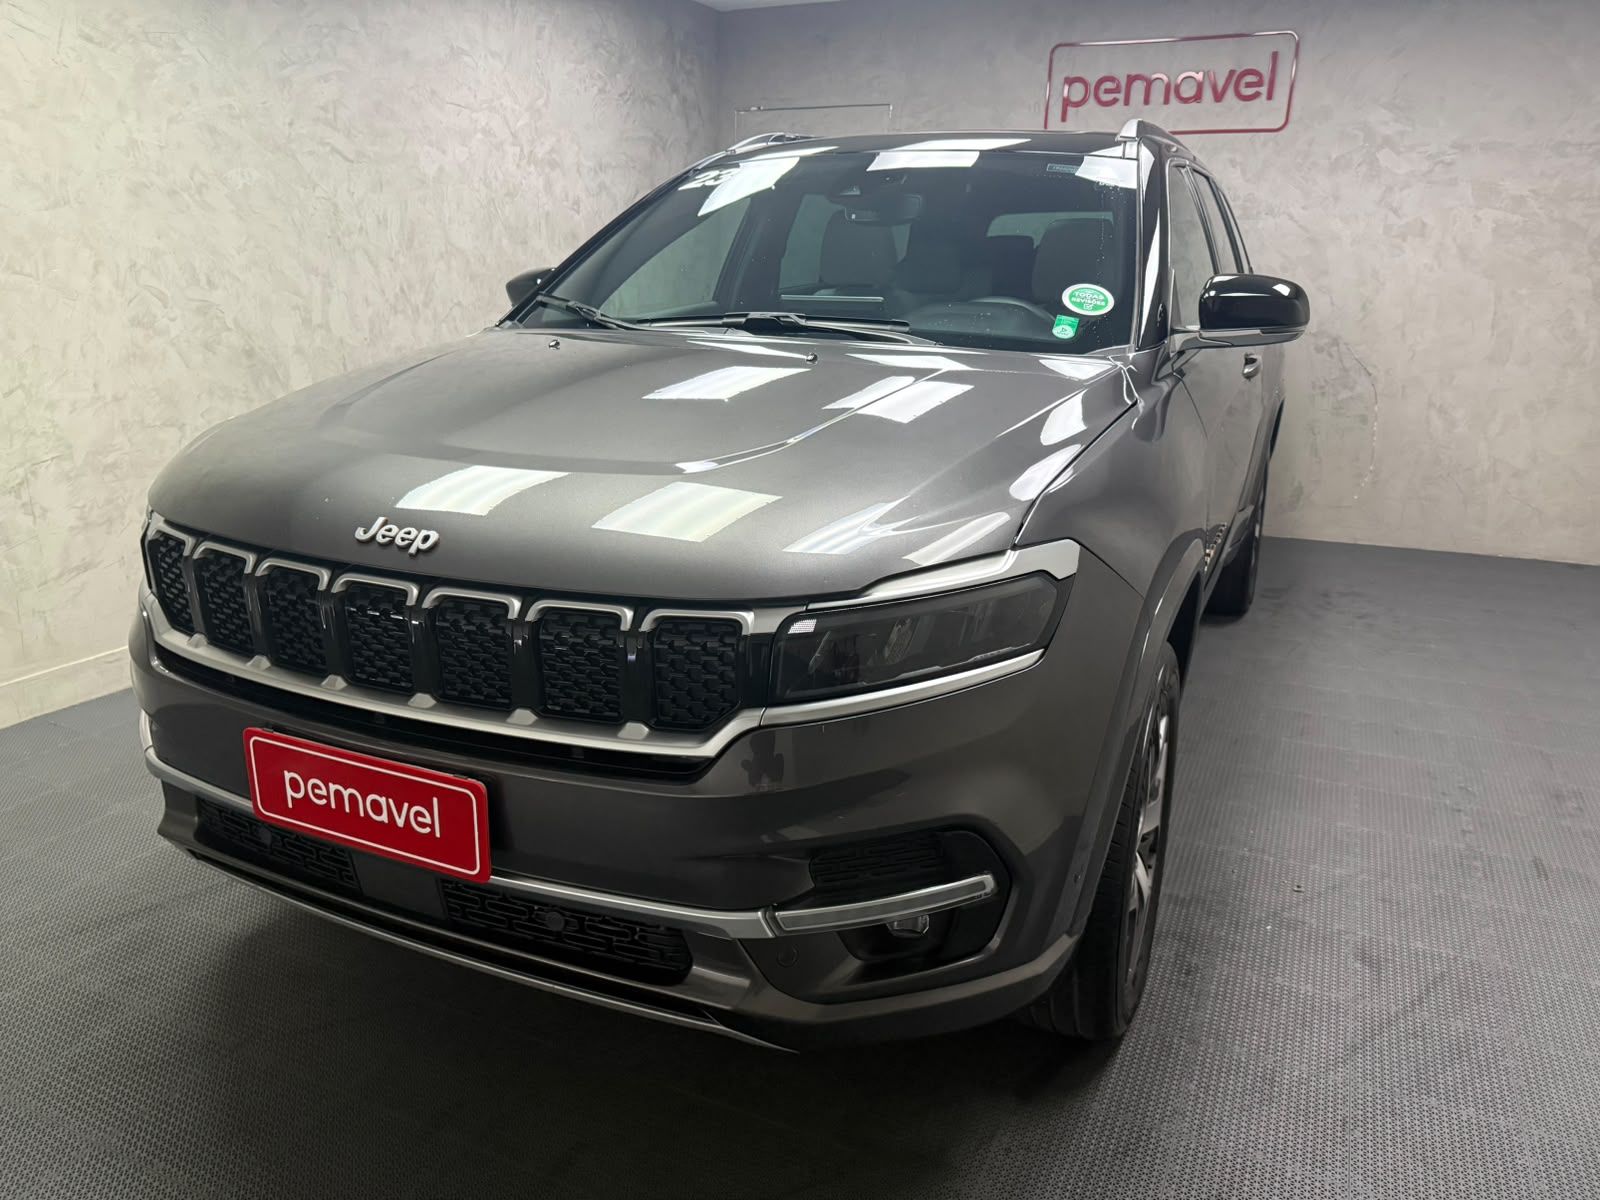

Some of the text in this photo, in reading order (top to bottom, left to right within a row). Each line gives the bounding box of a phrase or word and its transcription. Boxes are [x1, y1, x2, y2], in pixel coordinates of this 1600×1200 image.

[1061, 51, 1279, 122] pemavel
[1075, 291, 1105, 300] TODAS
[354, 516, 440, 557] Jeep
[284, 769, 441, 838] pemavel
